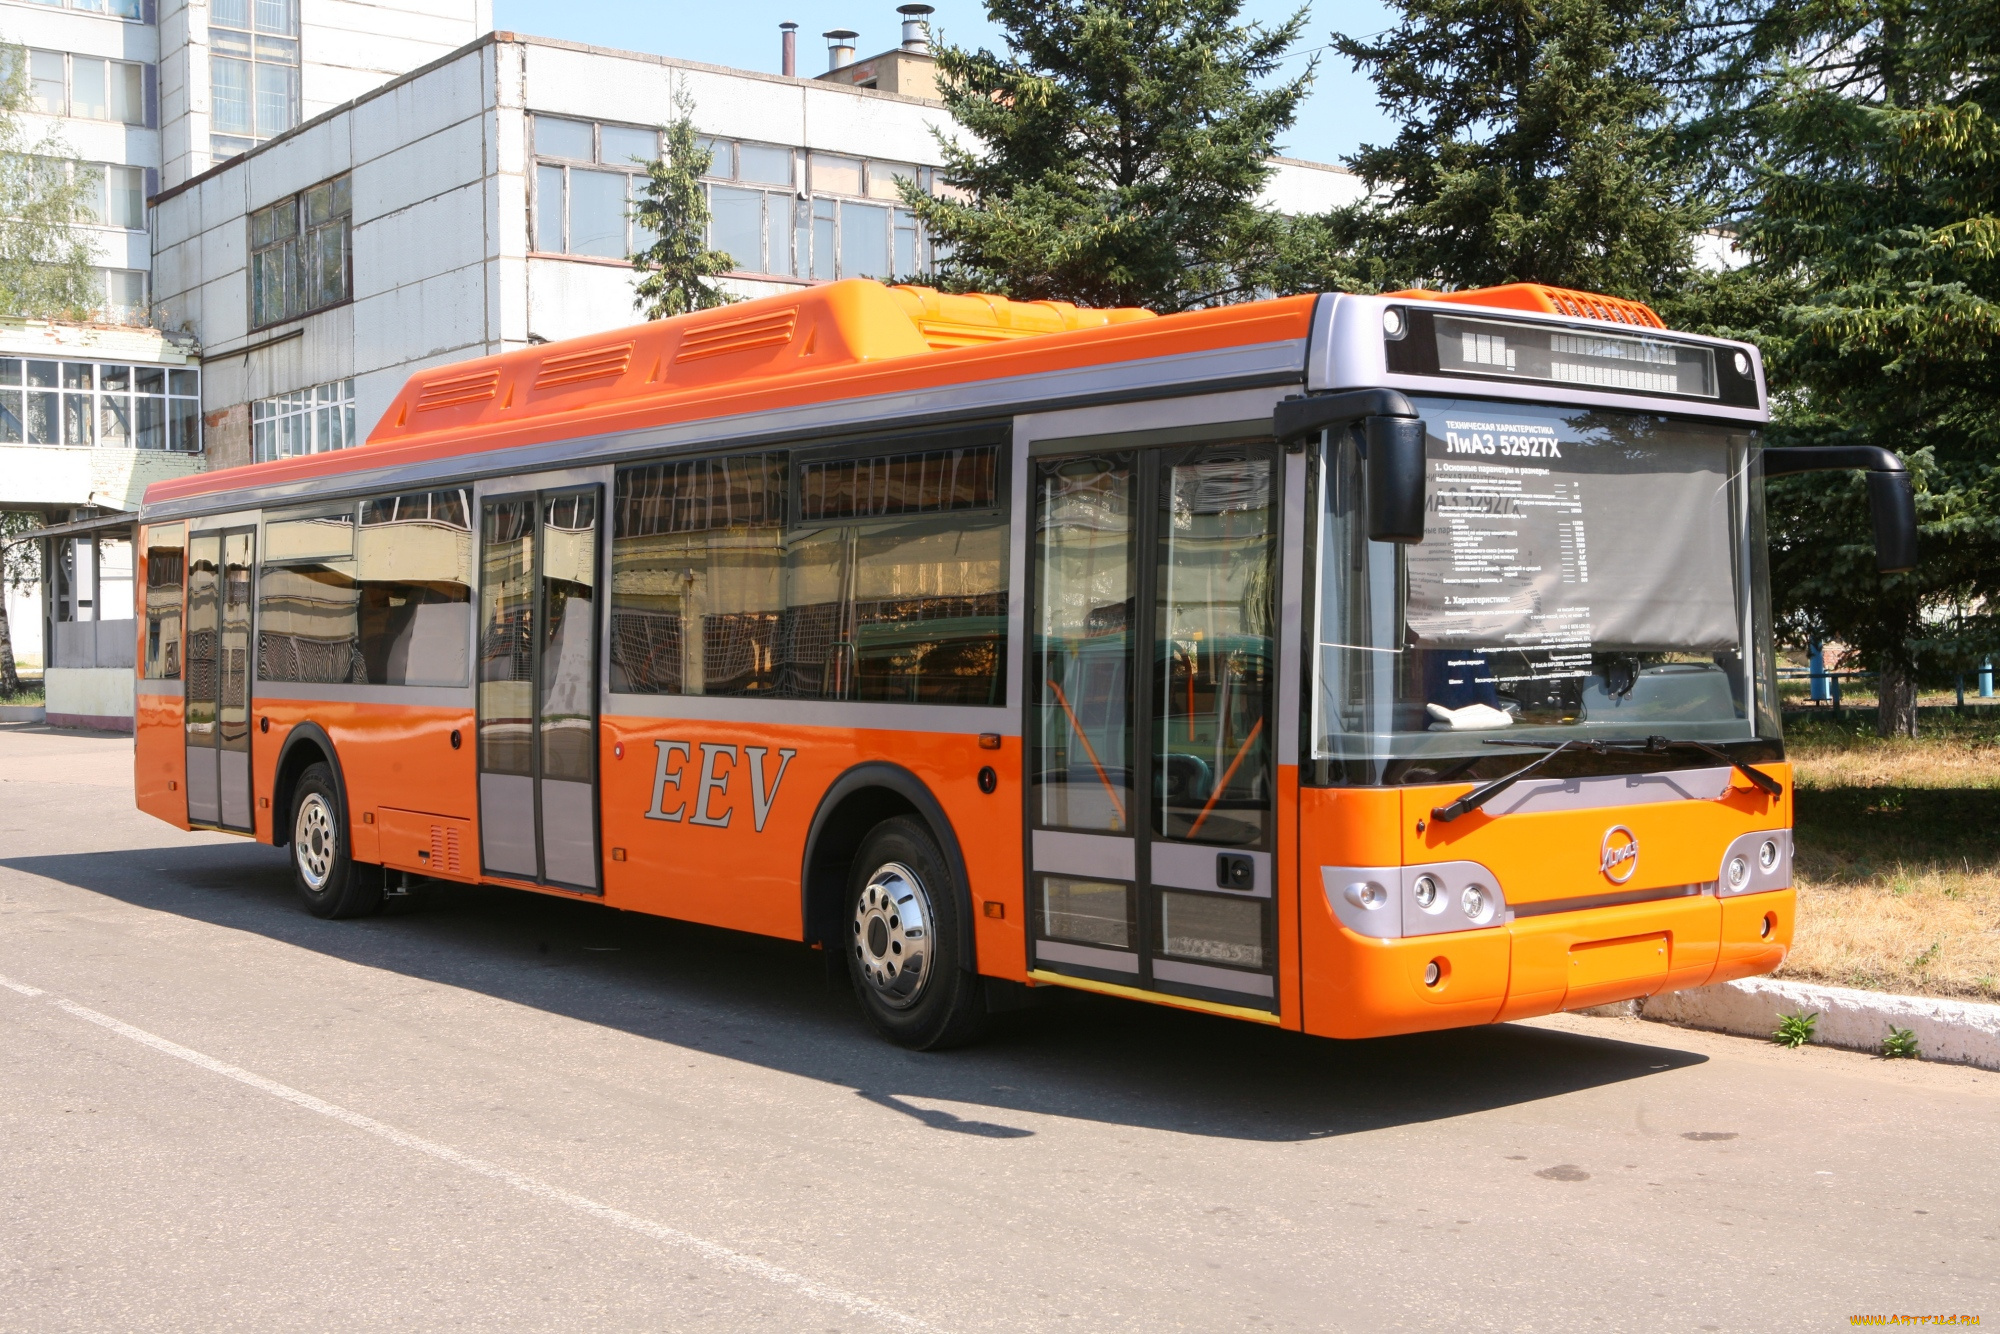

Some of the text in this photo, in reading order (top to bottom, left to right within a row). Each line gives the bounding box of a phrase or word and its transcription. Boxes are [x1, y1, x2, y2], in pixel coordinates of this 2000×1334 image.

[1446, 420, 1554, 434] ТЕХНИЧЕСКАЯ ХАРАКТЕРИСТИКА
[1446, 432, 1562, 458] ЛиАЗ 52927Х
[1443, 463, 1477, 472] Основные
[1478, 465, 1514, 475] параметры
[1520, 467, 1550, 476] размеры:
[1453, 596, 1510, 605] Характеристики:
[644, 739, 797, 833] EEV
